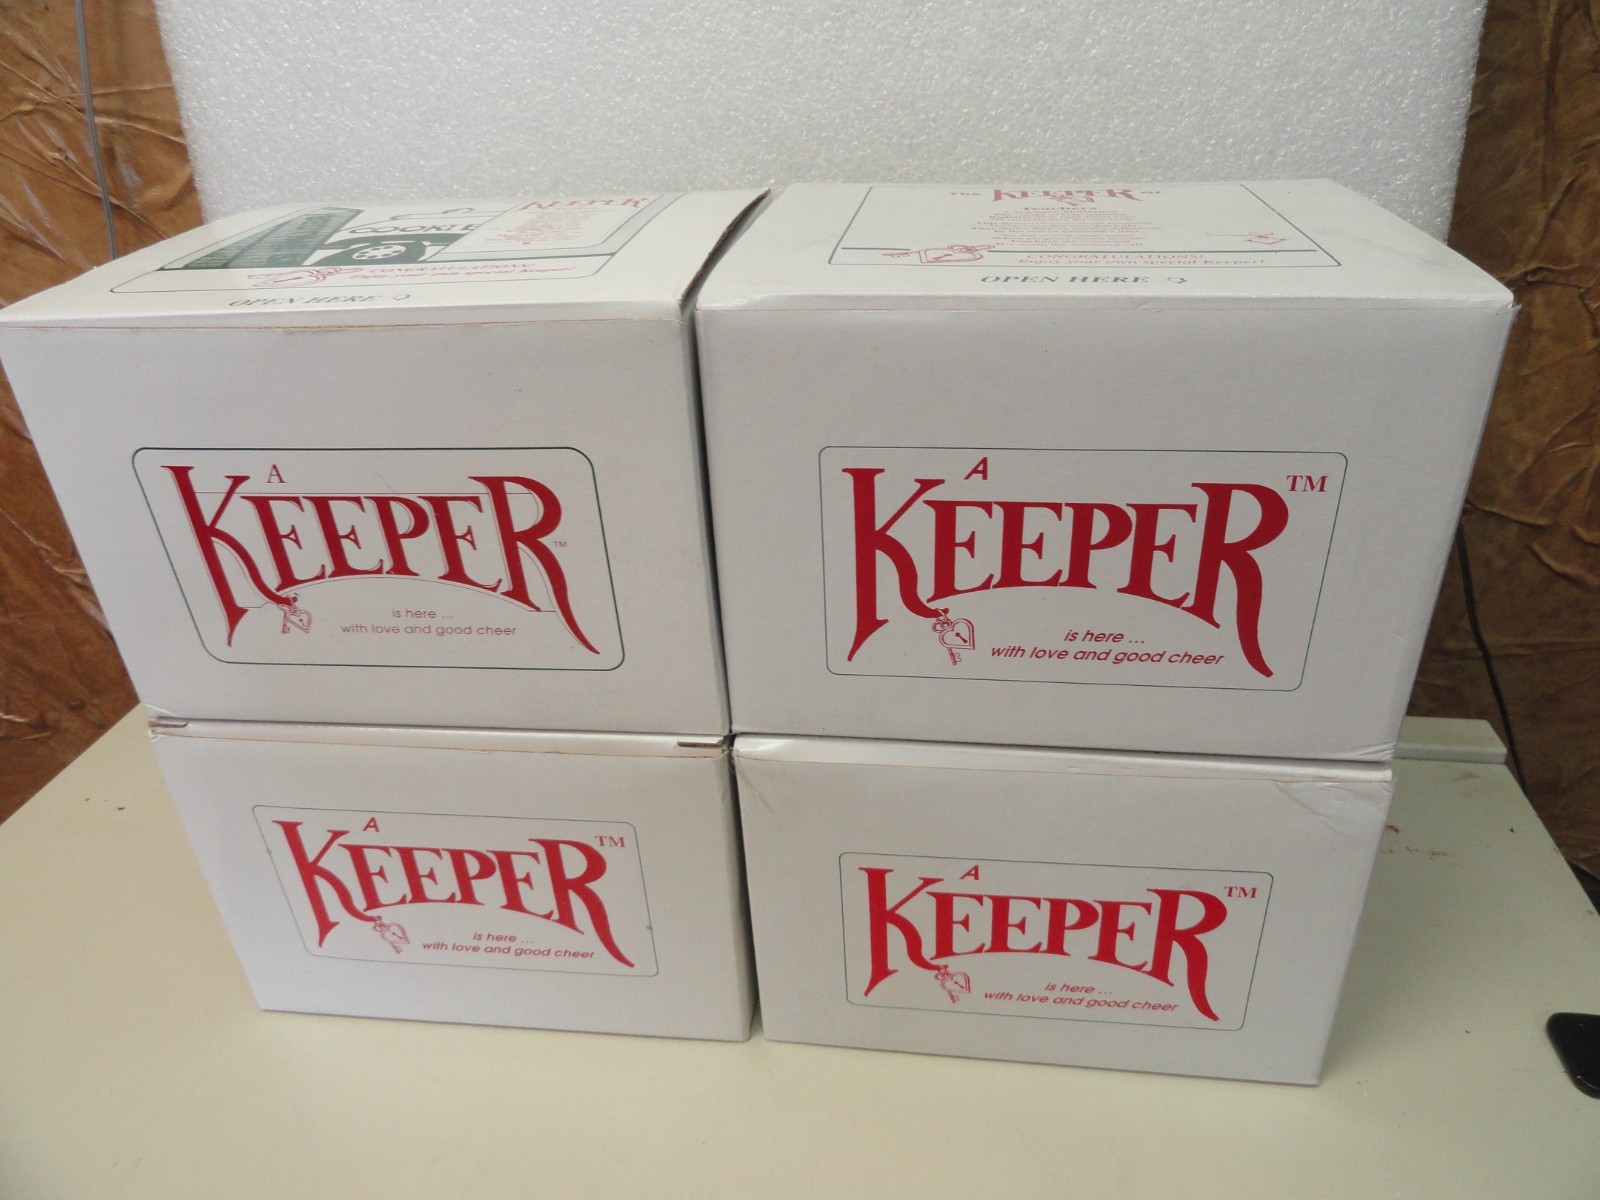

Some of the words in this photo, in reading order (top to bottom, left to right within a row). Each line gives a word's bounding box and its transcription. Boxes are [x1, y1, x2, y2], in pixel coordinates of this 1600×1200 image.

[981, 275, 1060, 283] OPEN
[1068, 275, 1150, 283] HERE
[228, 297, 304, 306] OPEN
[304, 295, 383, 304] HERE
[266, 464, 287, 485] A
[964, 457, 989, 481] A
[160, 465, 600, 654] KEEPER
[842, 468, 1289, 677] KEEPER
[1286, 475, 1328, 493] TM
[392, 607, 402, 619] is
[405, 607, 437, 619] here
[340, 623, 368, 635] with
[370, 623, 400, 635] love
[404, 624, 432, 636] and
[435, 625, 473, 639] good
[476, 625, 517, 637] cheer
[1064, 628, 1078, 642] is
[1081, 628, 1125, 643] here
[991, 644, 1025, 659] with
[1029, 645, 1069, 660] love
[1073, 646, 1108, 662] and
[1111, 648, 1165, 667] good
[1168, 648, 1225, 665] cheer
[362, 817, 380, 833] A
[960, 865, 980, 881] A
[272, 820, 635, 968] KEEPER
[594, 834, 626, 848] TM
[473, 931, 482, 941] is
[486, 932, 517, 944] here
[858, 866, 1228, 1022] KEEPER
[1223, 885, 1259, 899] TM
[422, 940, 449, 951] with
[451, 941, 480, 953] love
[483, 944, 511, 955] and
[514, 945, 552, 959] good
[554, 947, 595, 960] cheer
[1045, 981, 1057, 991] is
[1059, 982, 1095, 994] here
[984, 990, 1015, 1002] with
[1017, 991, 1051, 1004] love
[1053, 993, 1084, 1006] and
[1086, 996, 1130, 1011] good
[1132, 999, 1180, 1013] cheer
